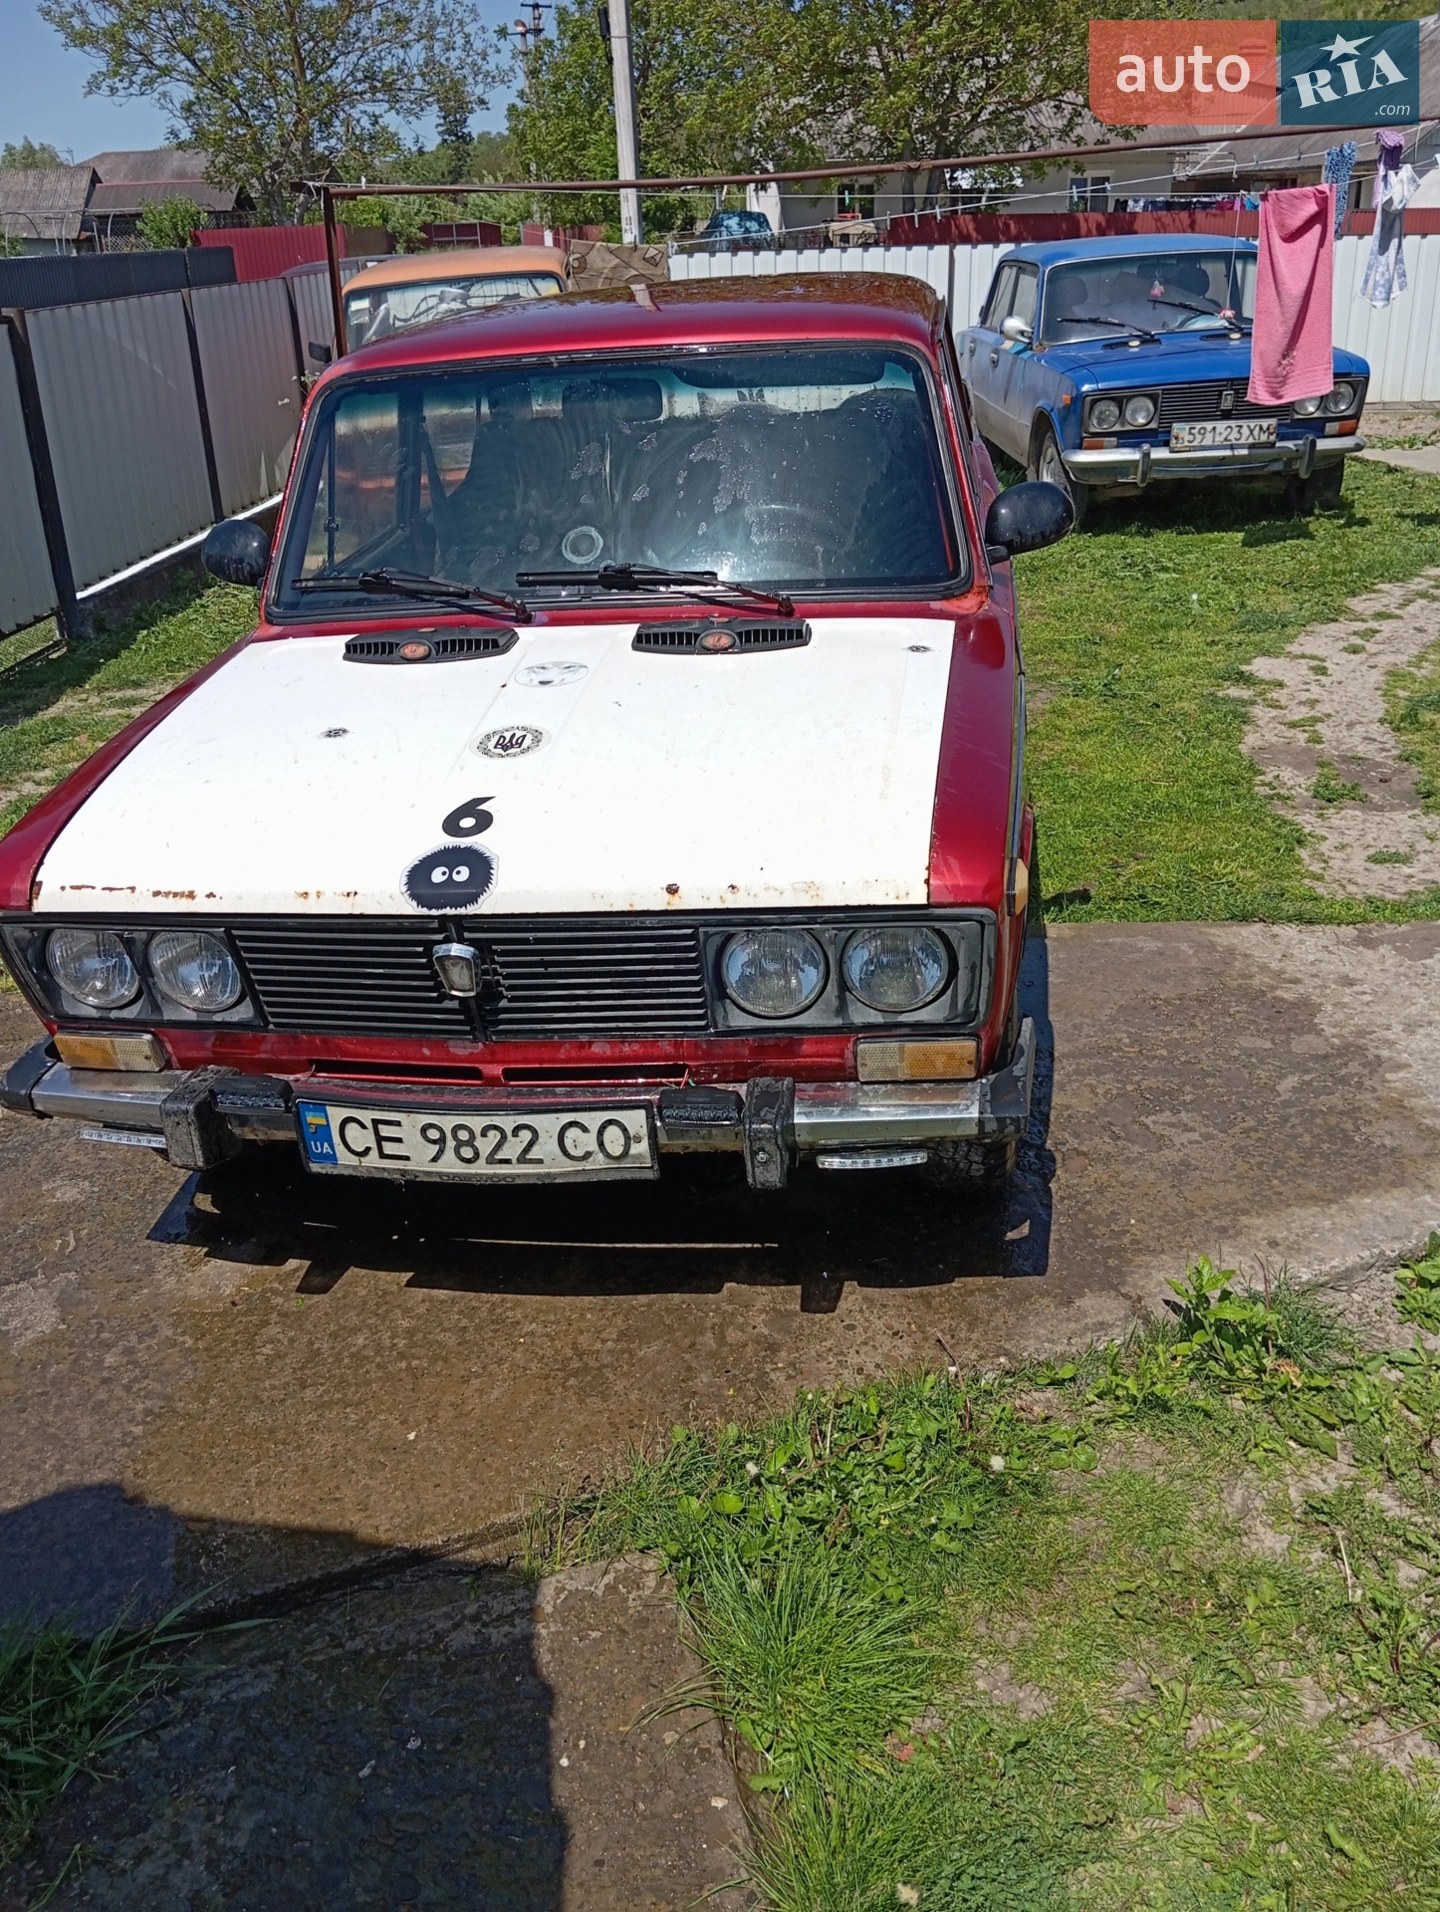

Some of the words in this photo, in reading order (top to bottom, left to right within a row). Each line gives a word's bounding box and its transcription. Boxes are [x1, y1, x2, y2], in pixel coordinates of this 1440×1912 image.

[442, 795, 497, 838] 6
[310, 1140, 334, 1155] UA
[338, 1115, 410, 1162] CE
[419, 1121, 544, 1165] 9822
[557, 1118, 632, 1161] CO
